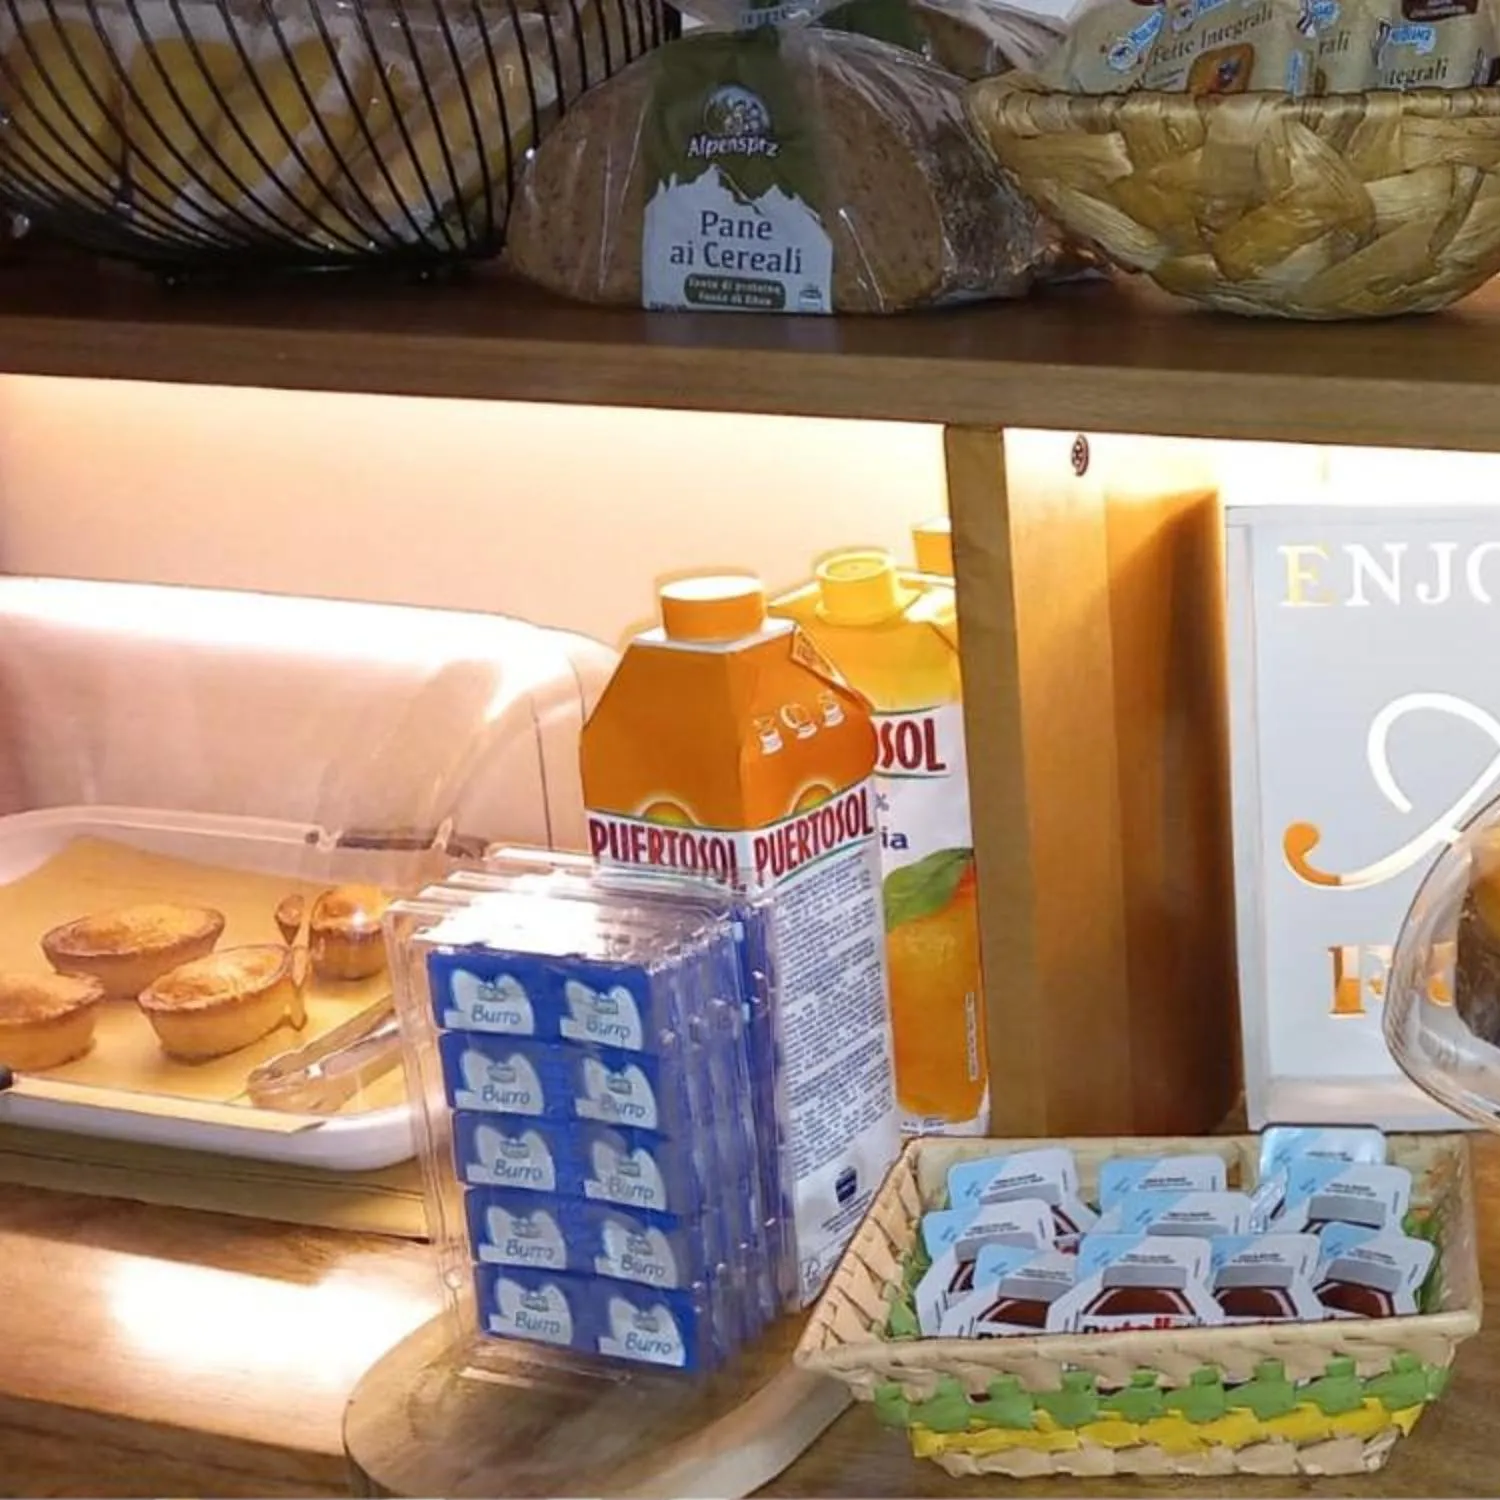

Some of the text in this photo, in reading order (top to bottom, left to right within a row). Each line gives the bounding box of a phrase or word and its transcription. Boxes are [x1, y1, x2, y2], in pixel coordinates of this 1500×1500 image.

[1201, 3, 1273, 49] Integrali
[1318, 31, 1349, 55] rali
[1384, 57, 1448, 85] tegrali
[687, 134, 781, 159] Alpenspitz
[700, 209, 773, 241] Pane
[670, 241, 801, 275] ai Cereali
[878, 717, 947, 772] SOL
[754, 785, 874, 888] PUERTOSOL
[589, 817, 746, 895] PUERTOSOL
[471, 1004, 522, 1026] Burro
[585, 1017, 632, 1039] Burro
[481, 1084, 531, 1106] Burro
[493, 1159, 543, 1180] Burro
[505, 1239, 555, 1260] Burro
[620, 1254, 665, 1277] Burro
[515, 1311, 561, 1335] Burro
[625, 1331, 672, 1355] Burro
